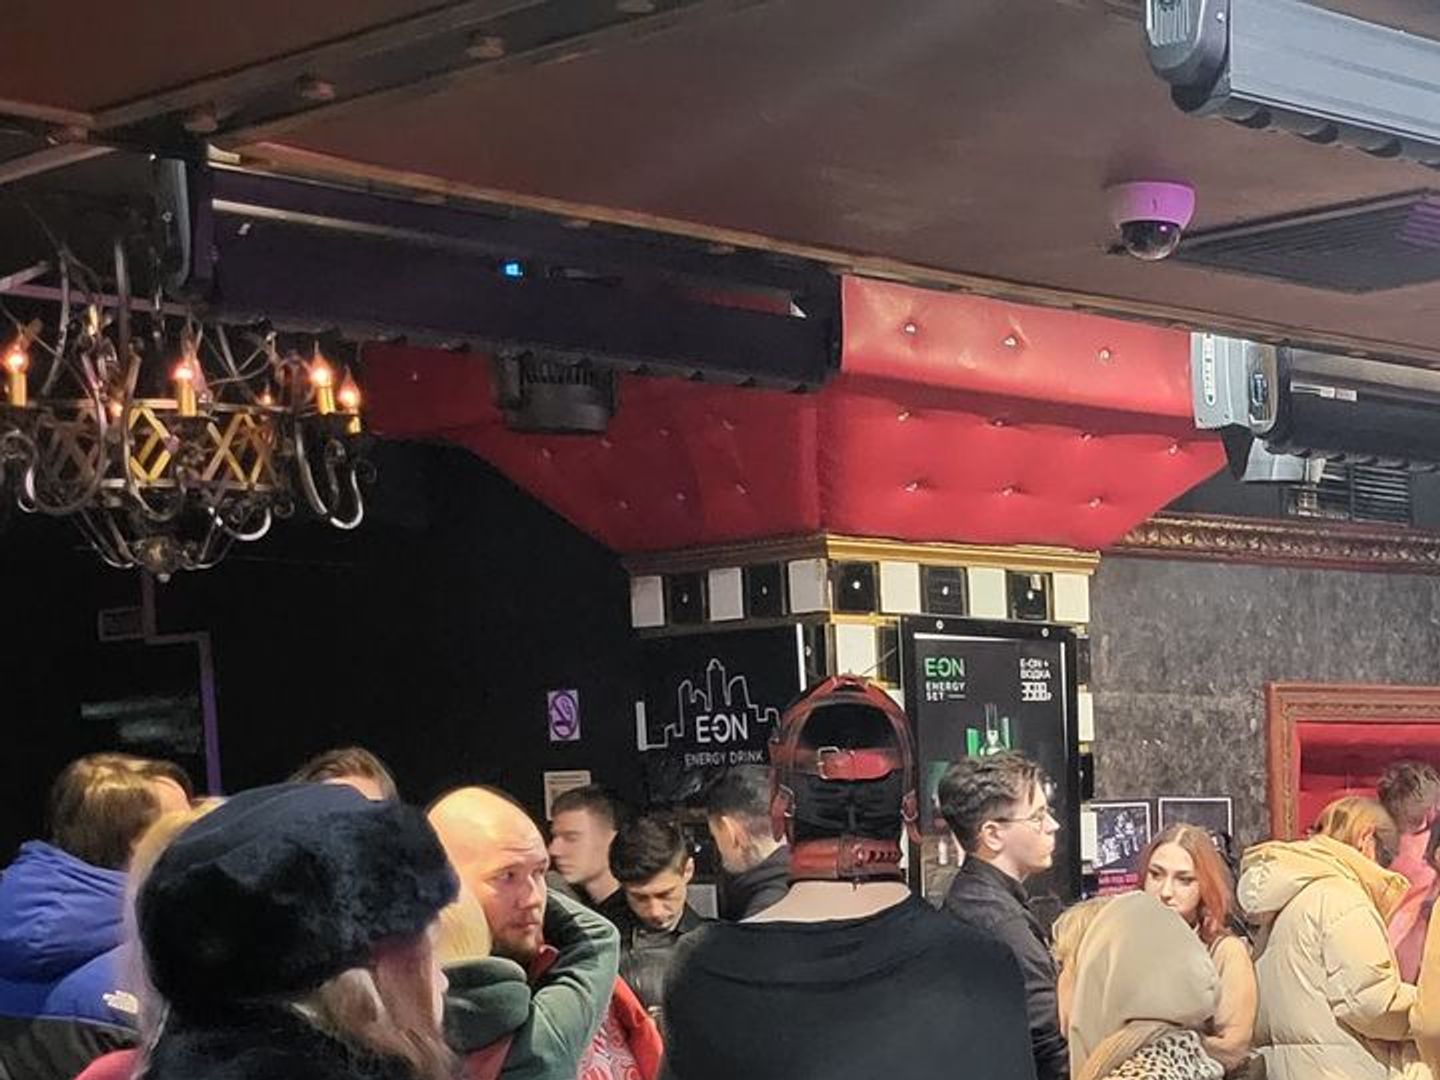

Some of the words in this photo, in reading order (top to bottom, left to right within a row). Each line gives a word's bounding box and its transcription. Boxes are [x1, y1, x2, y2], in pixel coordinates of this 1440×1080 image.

[925, 681, 966, 692] ENERGY
[926, 691, 944, 701] SET
[684, 752, 726, 768] ENERGY
[729, 750, 764, 766] DRINK
